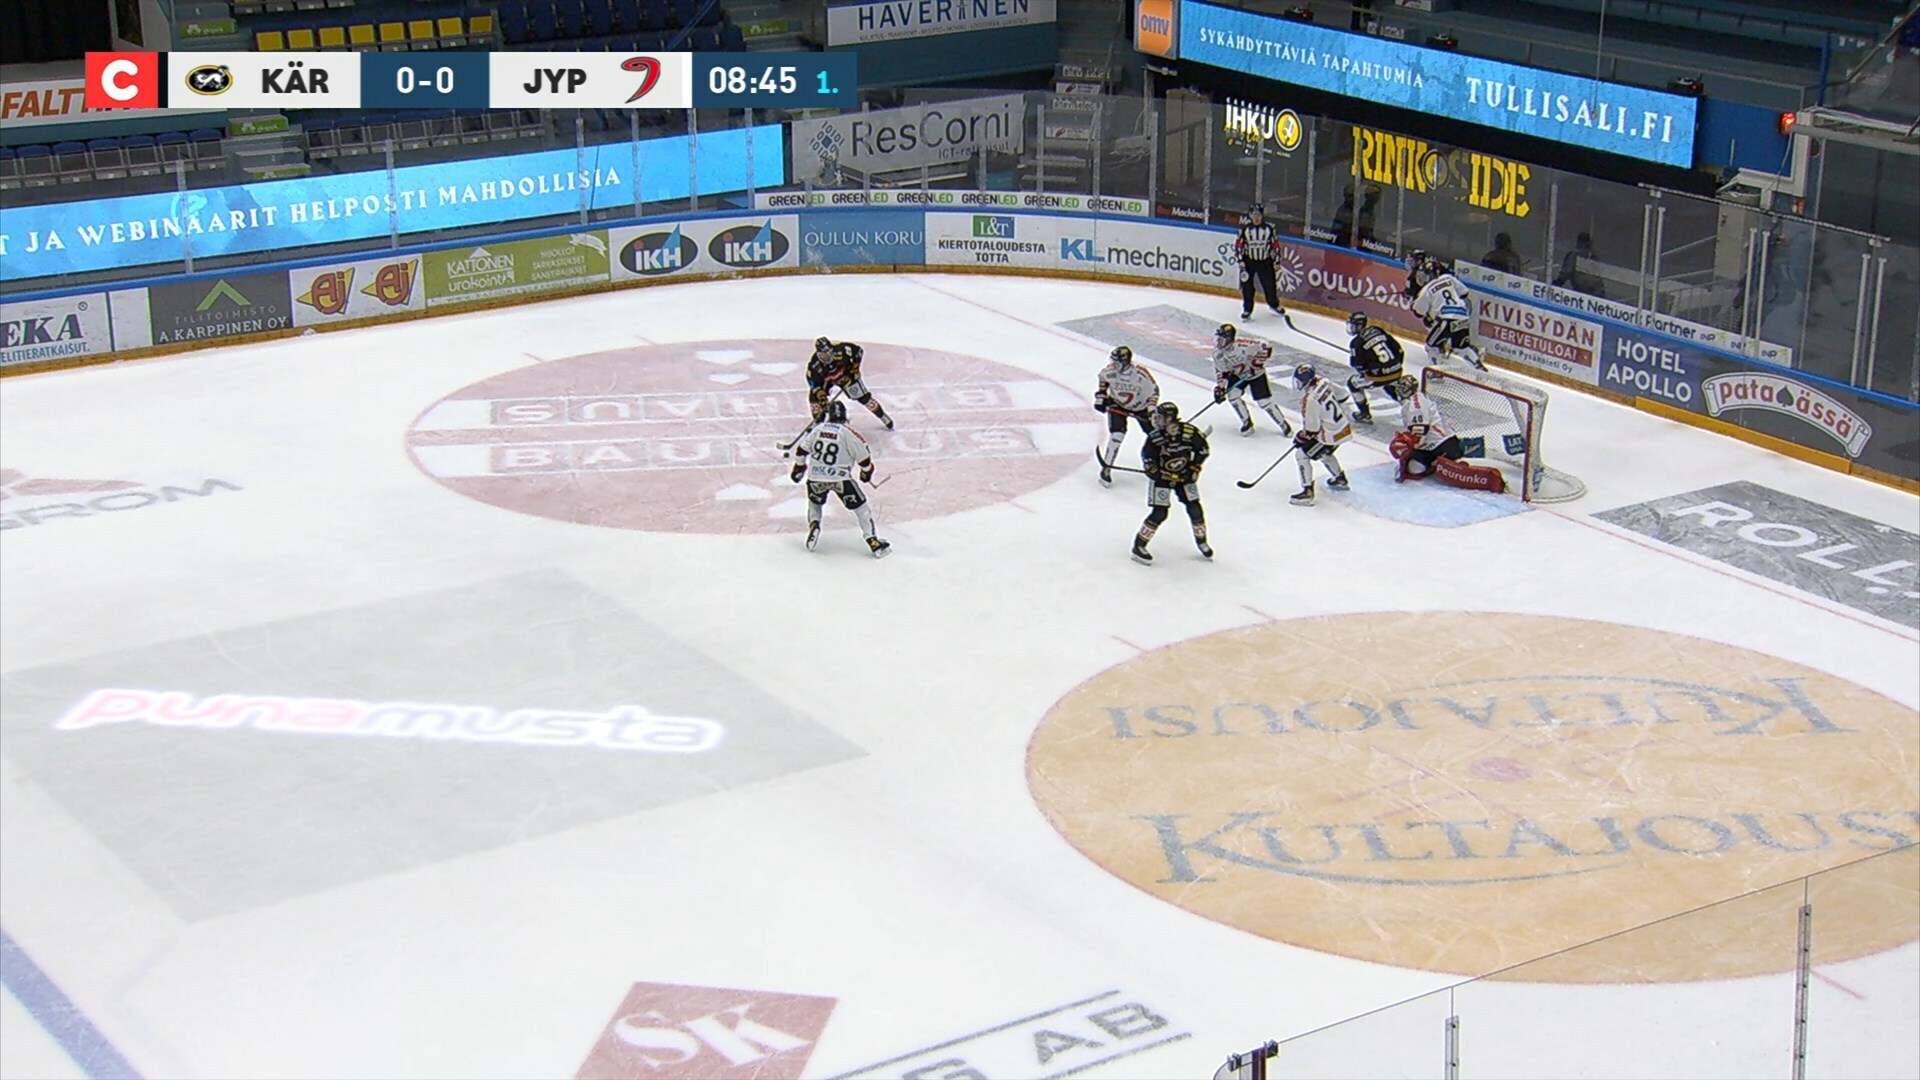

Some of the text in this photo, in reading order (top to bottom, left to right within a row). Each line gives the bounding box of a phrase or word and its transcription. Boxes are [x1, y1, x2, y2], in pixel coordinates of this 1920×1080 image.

[1141, 14, 1170, 36] omv
[1199, 26, 1672, 143] SYKÄHDYTTÄVIÄ TAPAHTUMIA TULLISALI.FI
[1225, 98, 1275, 140] IHKU
[24, 230, 66, 253] JA
[77, 206, 278, 247] WEBINAARIT
[290, 189, 427, 224] HELPOSTI
[438, 167, 622, 207] MAHDOLLISIA
[979, 217, 1010, 236] L&T
[804, 230, 924, 247] OULUN KORU
[938, 239, 1046, 254] KIERTOTALOUDESTA
[447, 254, 515, 275] KATTONEN
[975, 252, 1009, 264] TOTTA
[1060, 237, 1224, 278] KL mechanics
[175, 304, 277, 325] TILITOIMISTO
[1533, 286, 1586, 311] Eficient
[158, 315, 289, 343] A.KARPPINEN OY
[1478, 299, 1595, 347] KIVISYDÄN
[1372, 341, 1395, 363] 51
[1617, 337, 1686, 375] HOTEL
[1605, 363, 1692, 403] APOLLO
[1718, 379, 1853, 439] pata ässä
[811, 440, 840, 466] 88
[1436, 463, 1488, 485] Peurunka
[64, 690, 717, 751] punamusta
[1100, 676, 1858, 741] KULTAJOUSI
[612, 1001, 812, 1068] SK
[1033, 1001, 1170, 1066] AB
